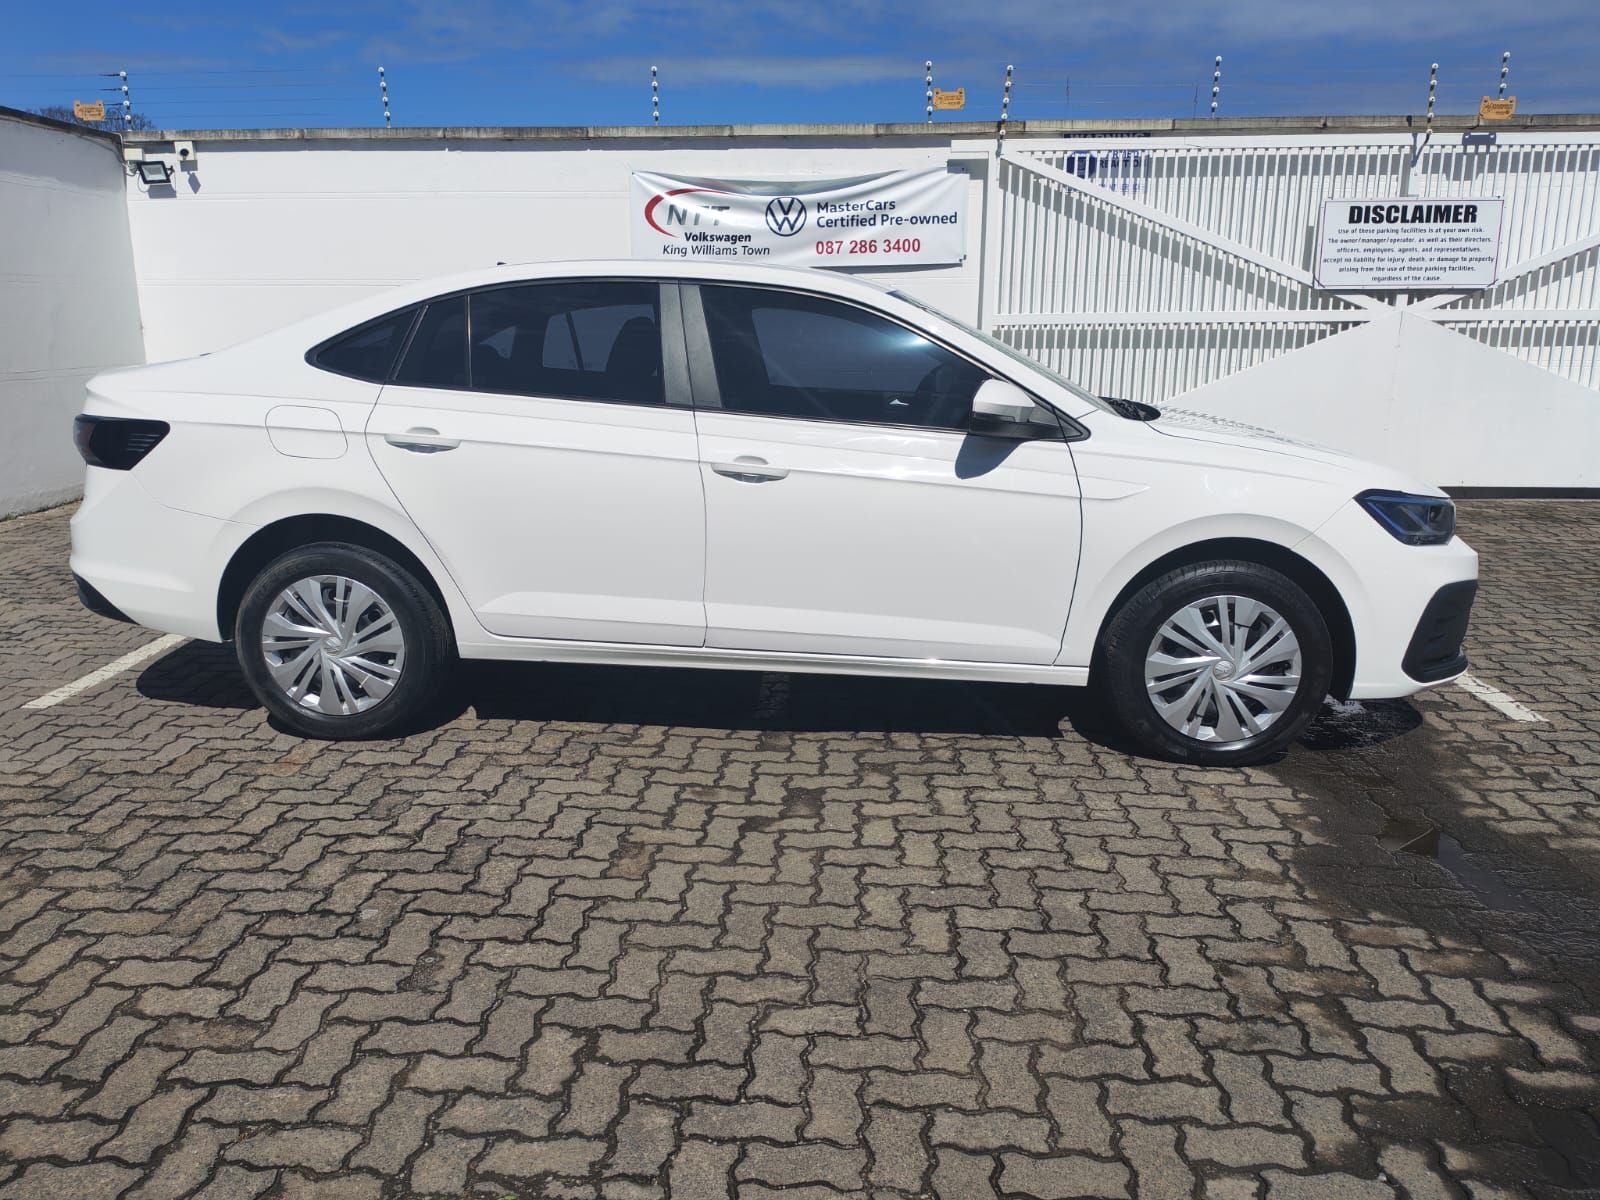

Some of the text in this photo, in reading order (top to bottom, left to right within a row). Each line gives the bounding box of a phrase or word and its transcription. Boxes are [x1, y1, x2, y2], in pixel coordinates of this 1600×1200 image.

[816, 200, 896, 213] MasterCars
[1348, 204, 1478, 224] DISCLAIMER
[816, 211, 959, 228] Certified Pre-owned
[684, 232, 752, 244] Volkswagen
[662, 245, 770, 257] King Williams Town
[815, 238, 921, 255] 087 286 3400
